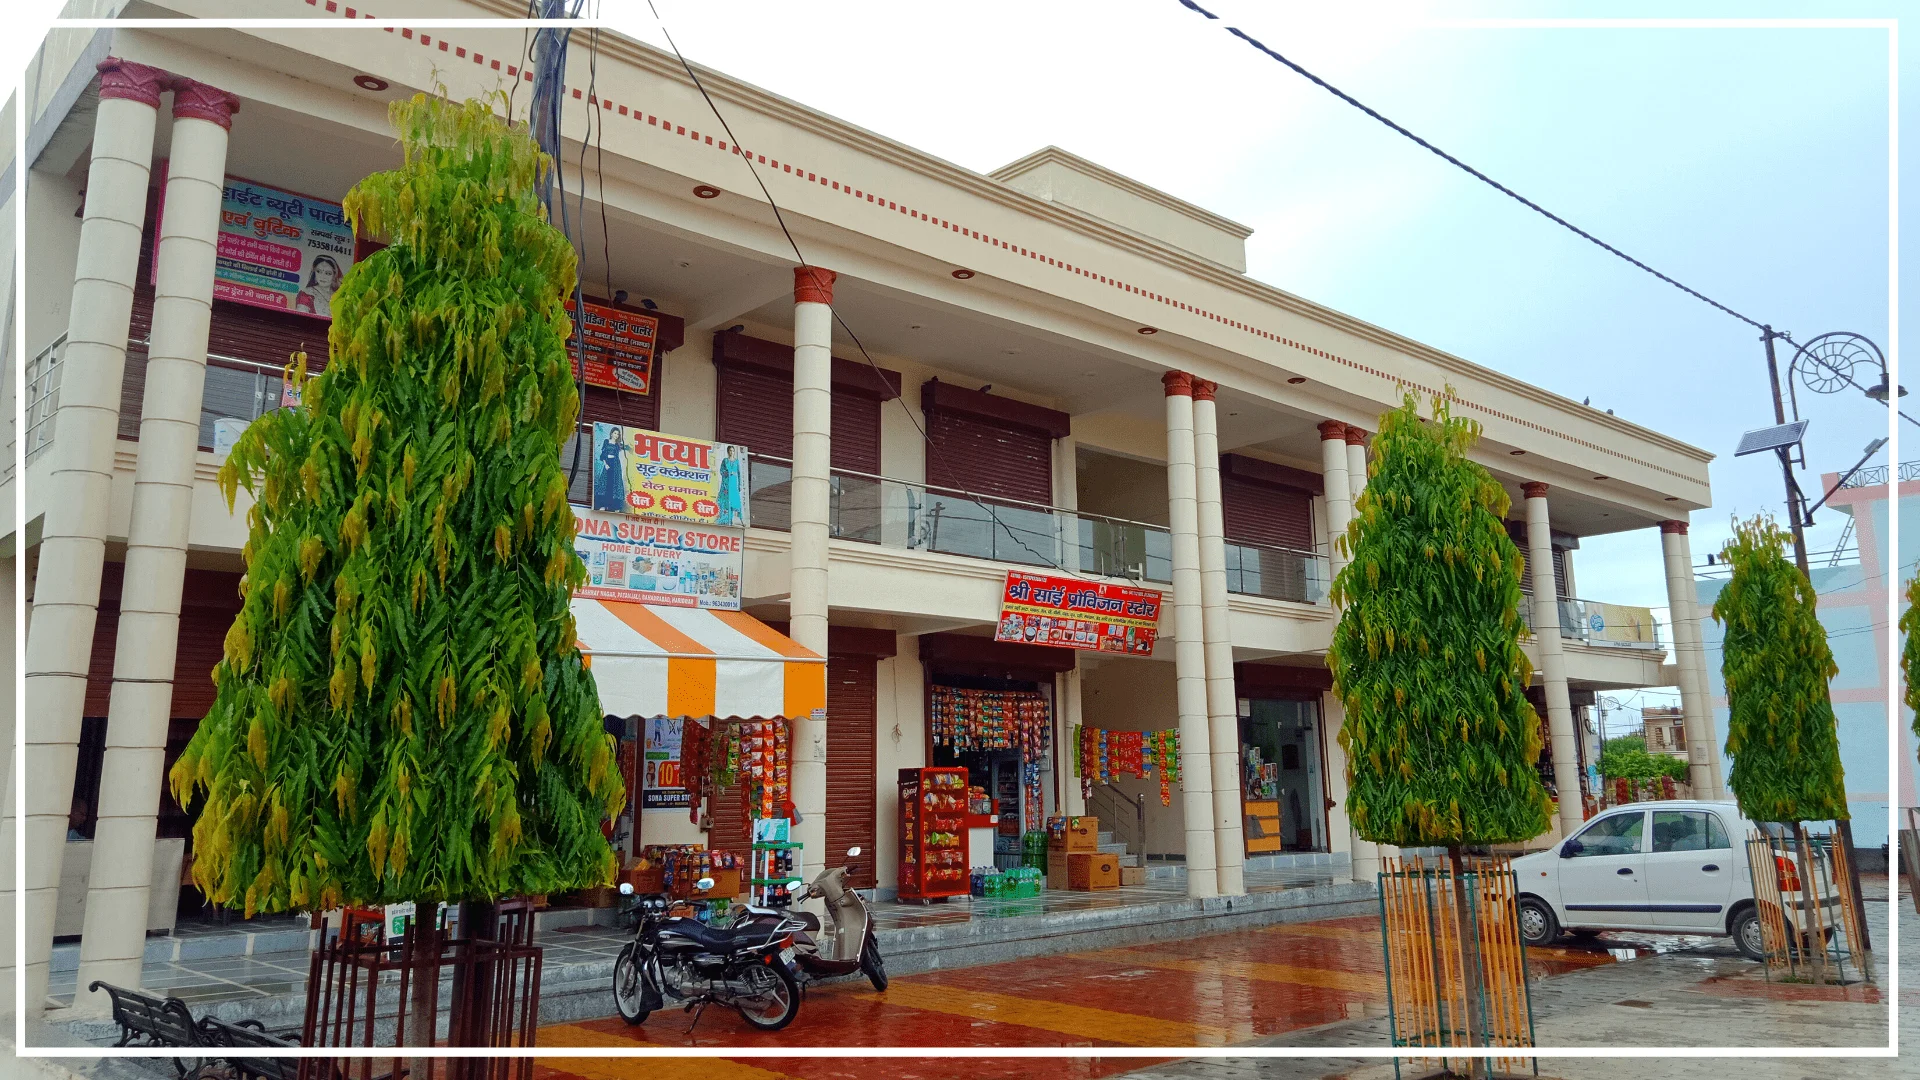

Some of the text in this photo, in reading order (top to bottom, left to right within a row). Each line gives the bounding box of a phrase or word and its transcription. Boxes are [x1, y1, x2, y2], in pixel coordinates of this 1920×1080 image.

[266, 196, 304, 219] ब्यूटी
[222, 210, 302, 238] एवं बुटिक
[307, 239, 352, 256] 7535814411
[634, 433, 712, 470] भव्या
[636, 462, 710, 482] सूट क्लेक्शन
[642, 480, 665, 491] सेल
[631, 492, 650, 507] सेल
[665, 496, 684, 511] सेल
[697, 500, 714, 515] सेल
[574, 516, 741, 552] ONA SUPER STORE
[601, 543, 682, 560] HOME DELIVERY
[1009, 580, 1031, 600] श्री
[1068, 590, 1124, 613] प्रोविजन
[1127, 598, 1156, 617] स्टोर
[659, 763, 674, 785] 10
[663, 794, 680, 802] SUPER
